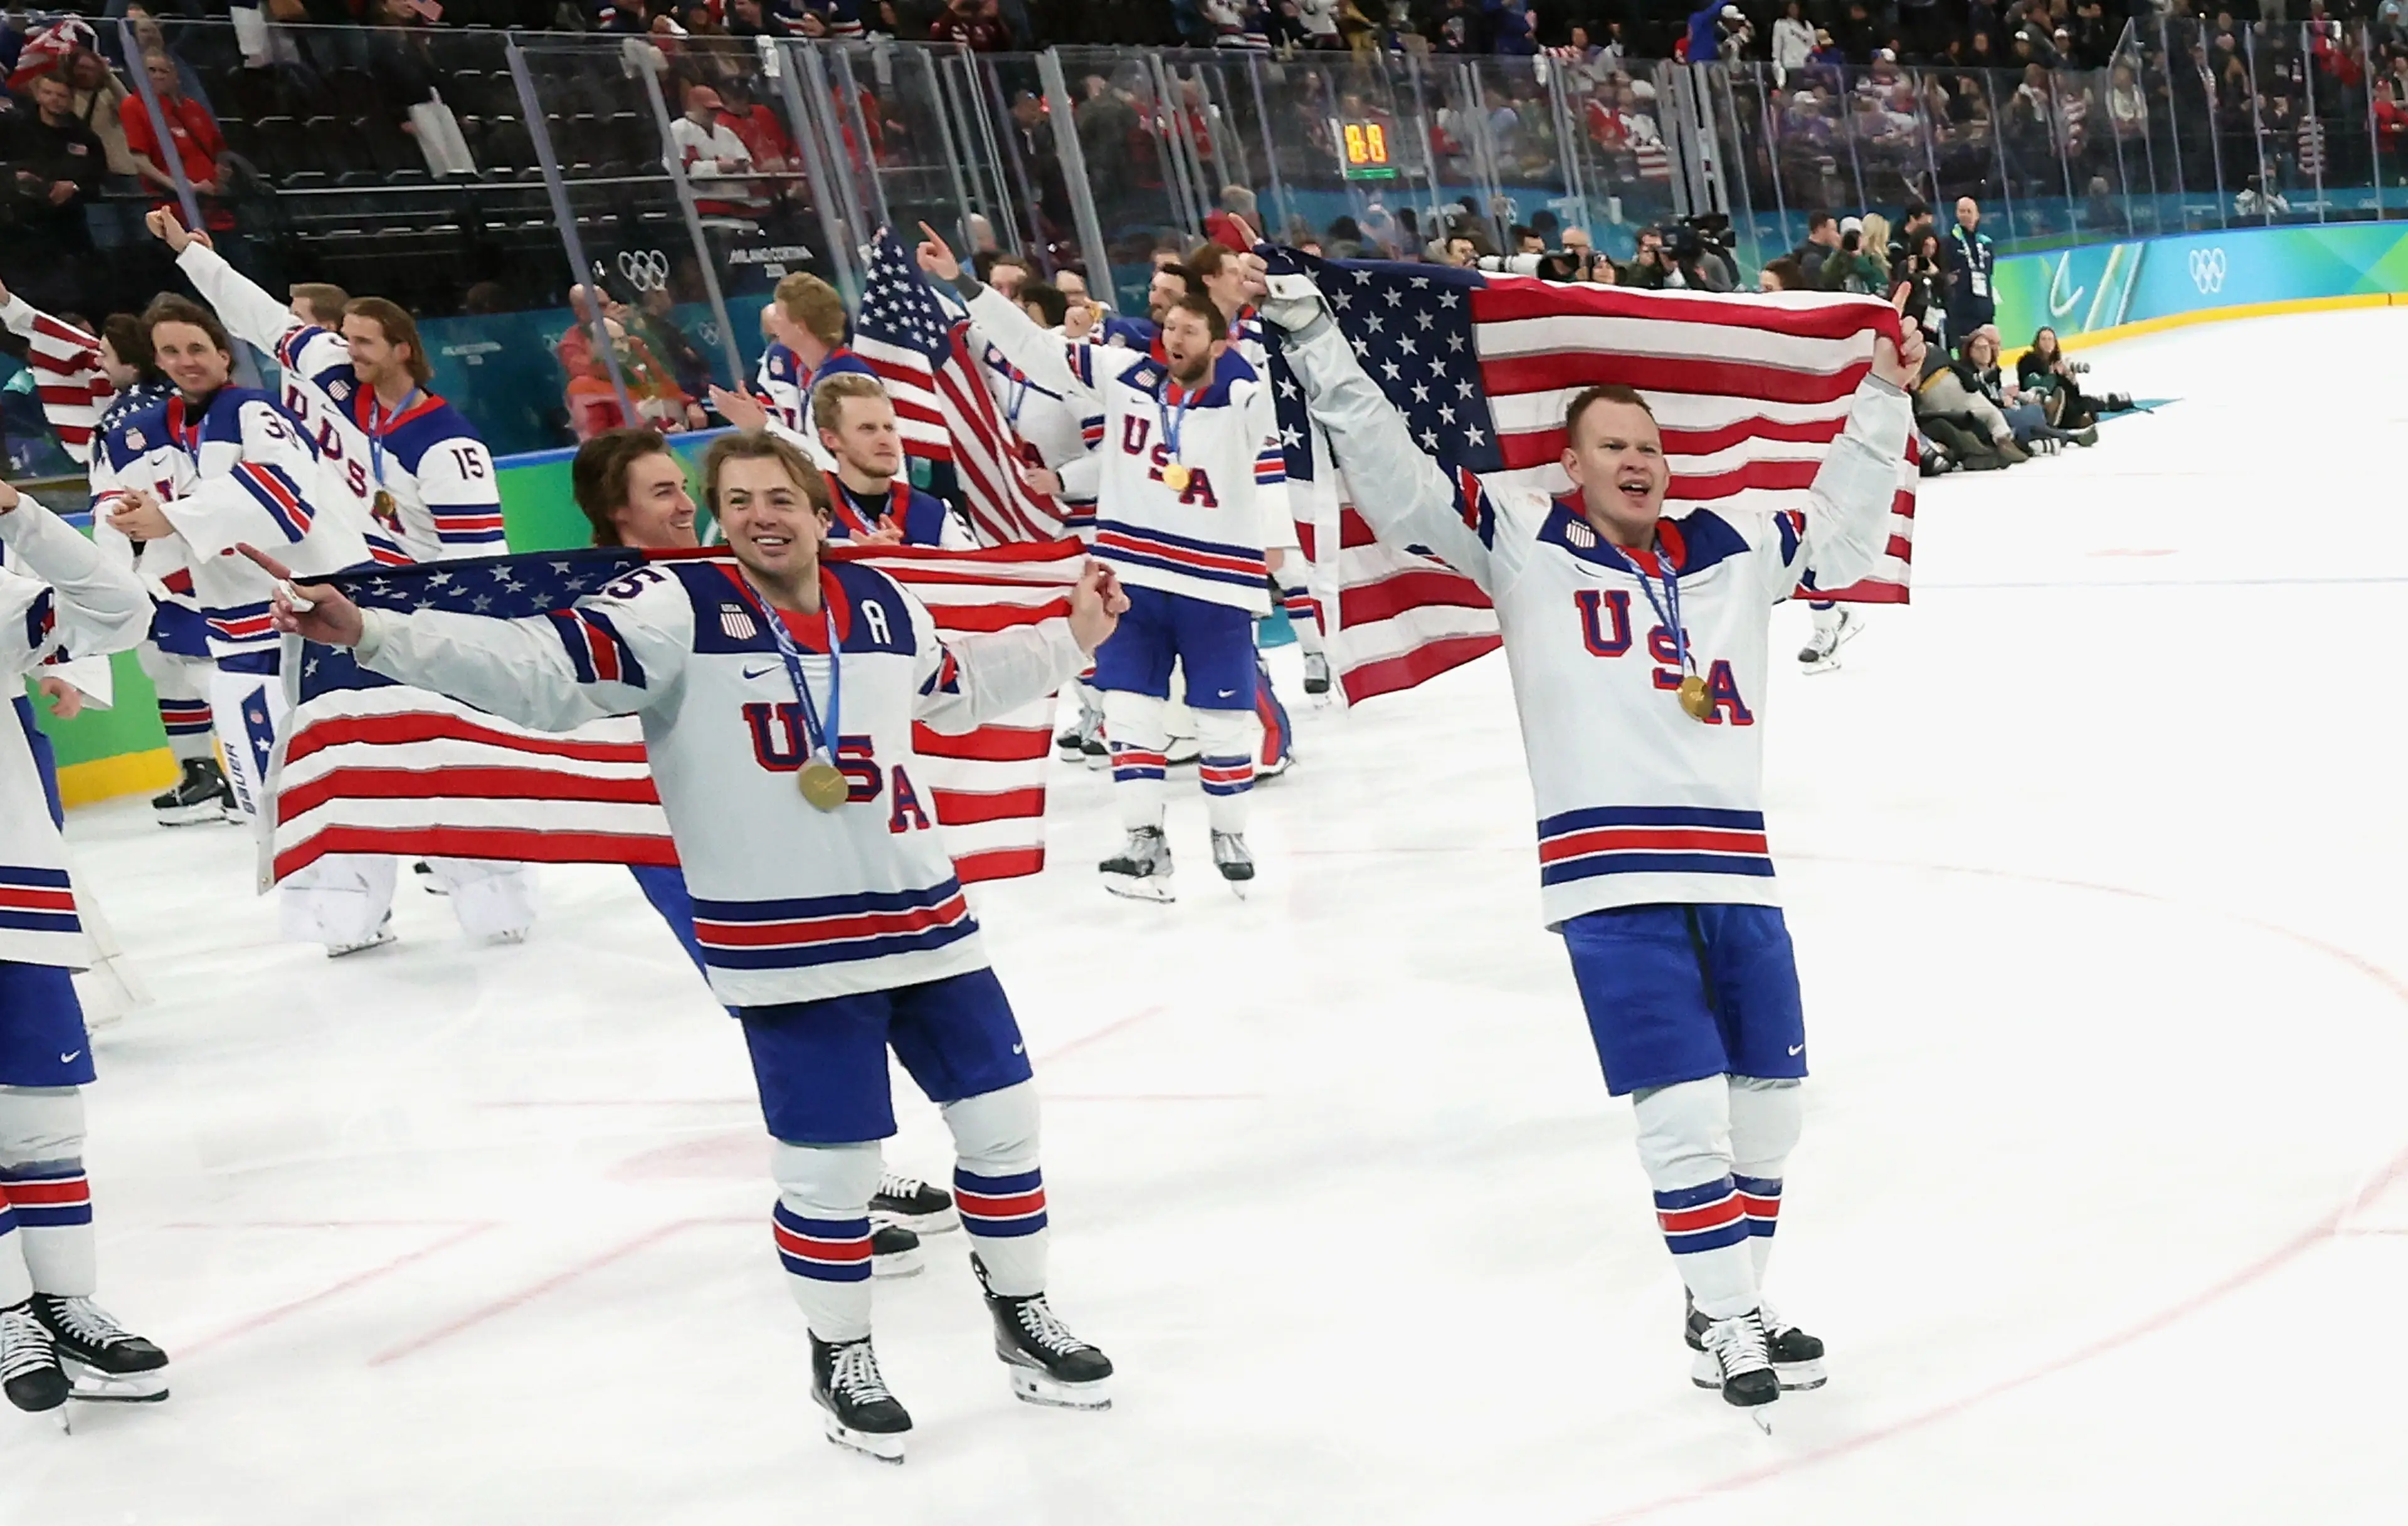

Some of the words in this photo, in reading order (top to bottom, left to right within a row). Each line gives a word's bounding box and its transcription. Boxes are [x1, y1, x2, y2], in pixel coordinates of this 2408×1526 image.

[450, 447, 484, 480] 15
[1122, 413, 1218, 508] USA
[861, 599, 892, 645] A
[1573, 589, 1755, 725] USA
[741, 702, 931, 834] USA
